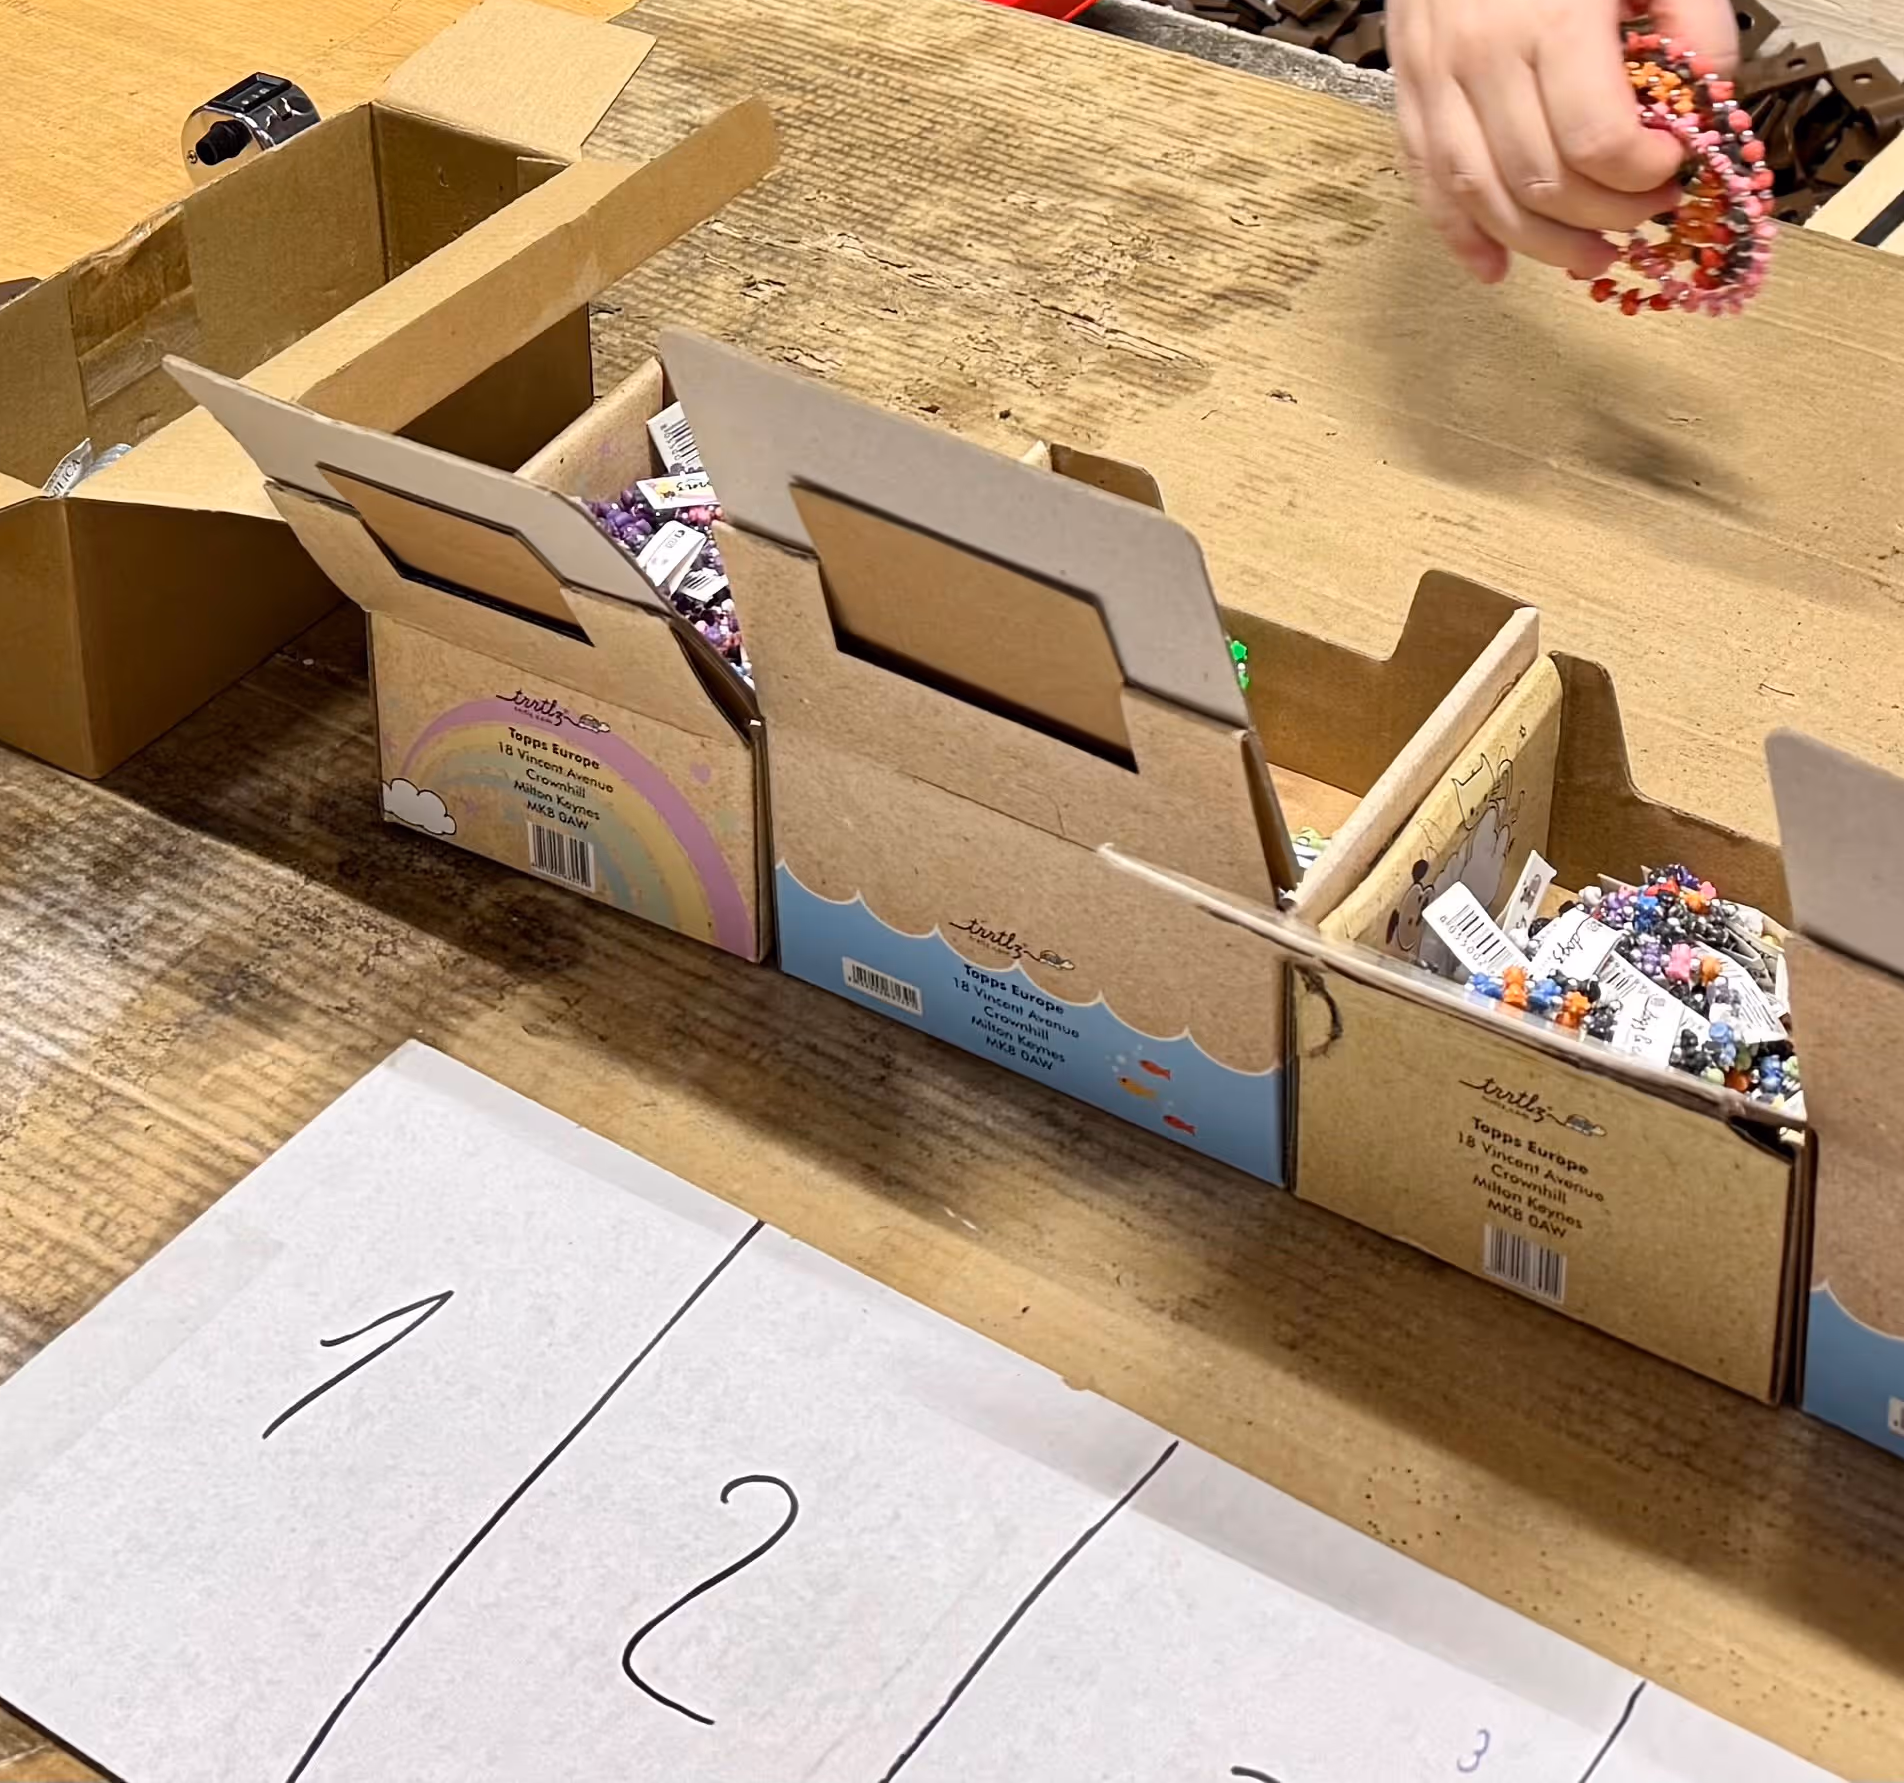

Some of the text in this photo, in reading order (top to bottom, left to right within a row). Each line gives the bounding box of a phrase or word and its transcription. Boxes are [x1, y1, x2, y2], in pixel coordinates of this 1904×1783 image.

[498, 741, 614, 793] 18 Vincent Avenue
[508, 726, 600, 770] Topps Europe
[514, 780, 600, 820] Milton Keynes
[526, 768, 585, 798] Crownhill
[953, 977, 1080, 1038] 18 Vincent Avenue
[964, 963, 1064, 1014] Topps Europe
[971, 1015, 1066, 1062] Milton Keynes
[984, 1006, 1049, 1041] Crownhill
[1458, 1131, 1605, 1202] 18 Vincent Avenue
[1472, 1116, 1589, 1175] Topps Europe
[1473, 1174, 1583, 1229] Milton Keynes
[1491, 1164, 1567, 1205] Crownhill
[262, 1290, 453, 1439] 1
[622, 1475, 799, 1725] 2
[1457, 1729, 1490, 1774] 3
